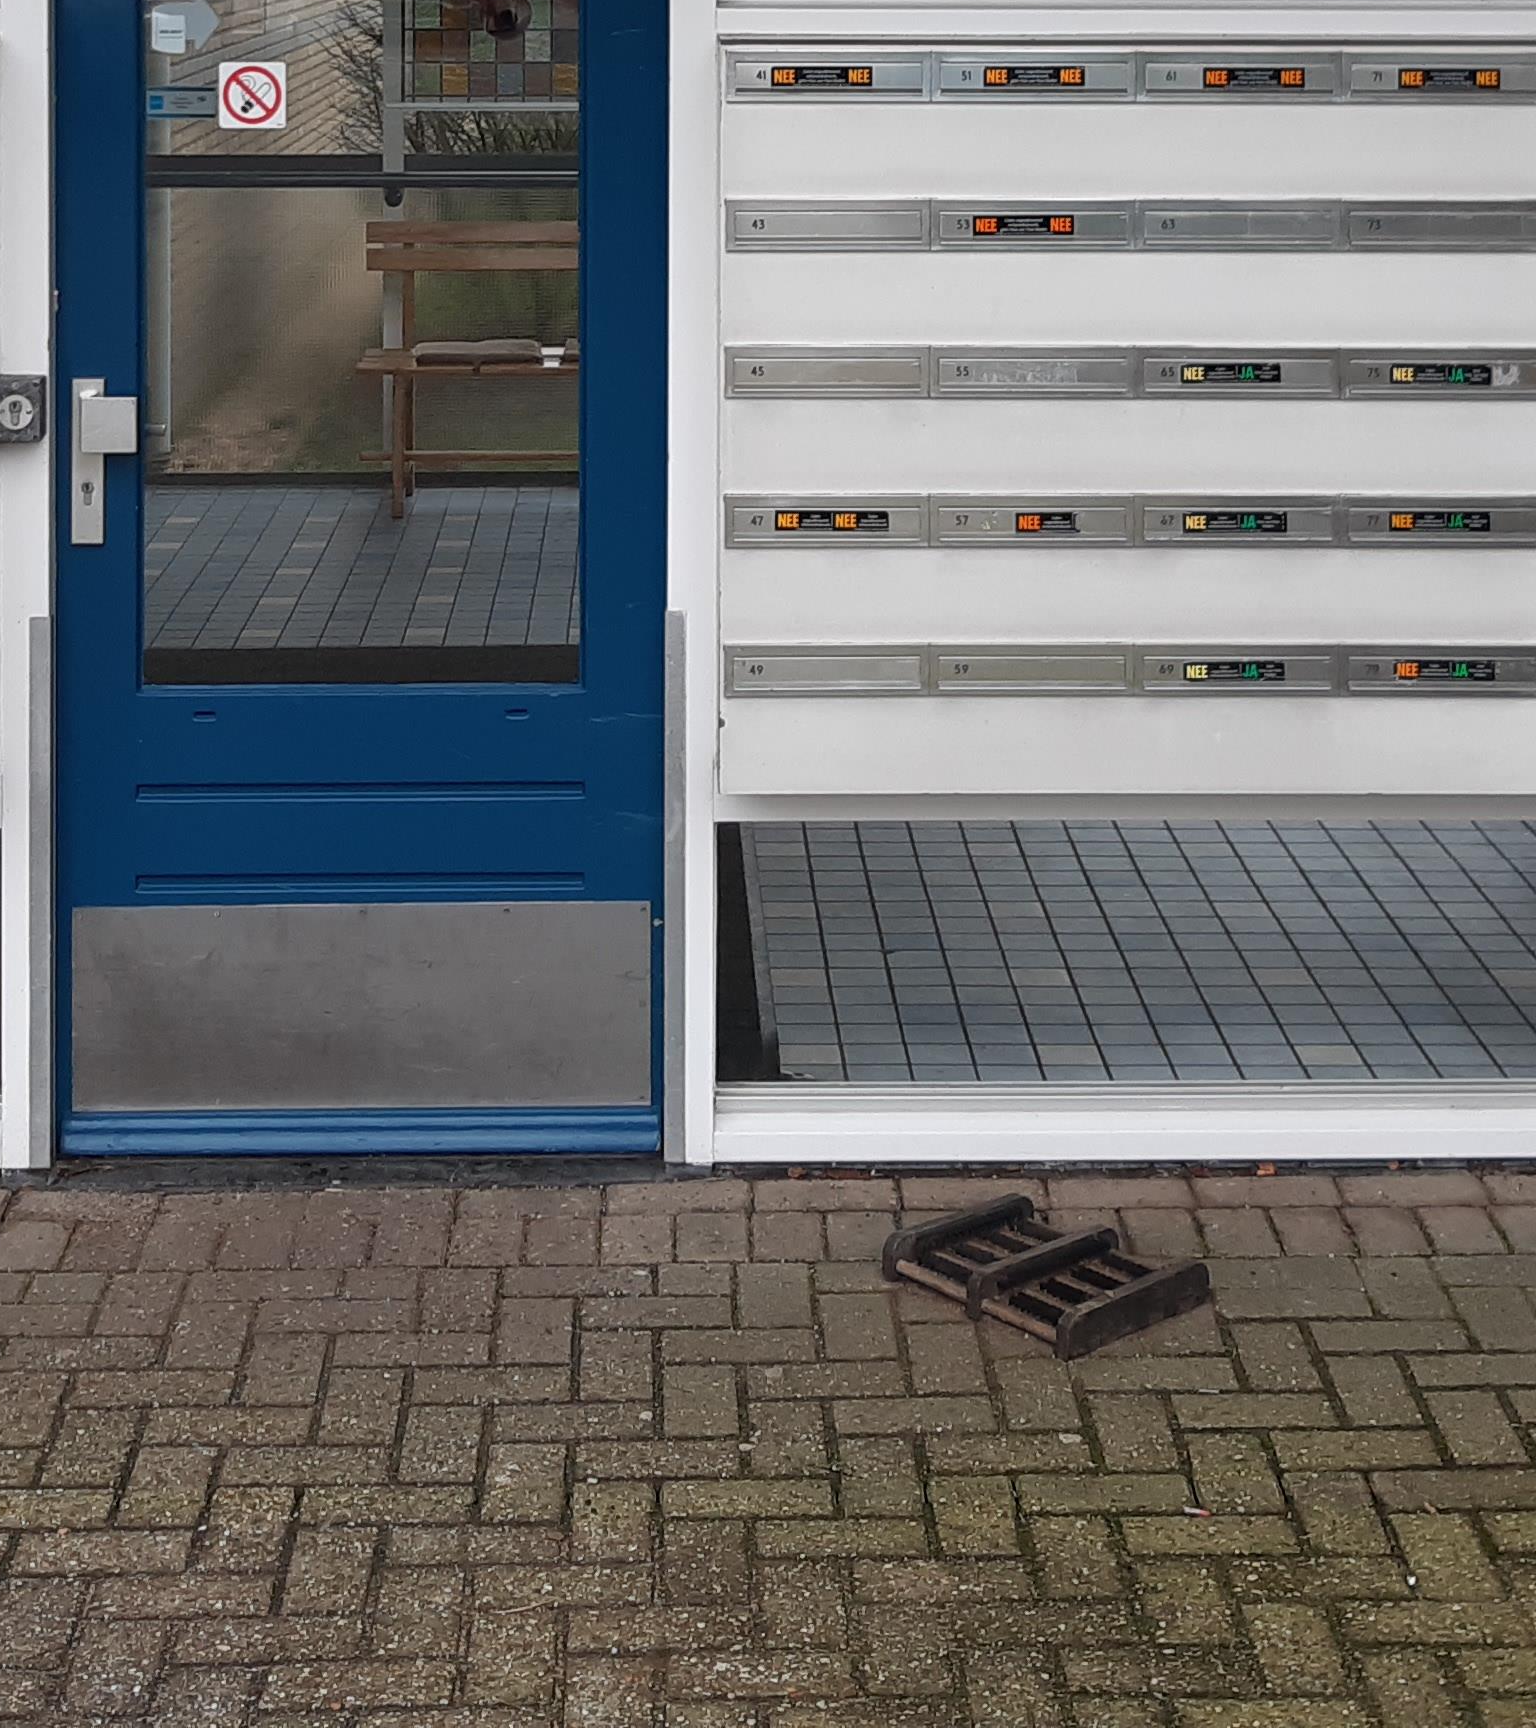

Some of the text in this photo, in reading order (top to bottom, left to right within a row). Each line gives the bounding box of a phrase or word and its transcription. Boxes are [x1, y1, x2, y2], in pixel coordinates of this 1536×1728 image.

[756, 69, 767, 81] 41
[774, 68, 795, 84] NEE
[849, 68, 870, 83] NEE
[961, 70, 972, 81] 51
[986, 68, 1008, 84] NEE
[1061, 68, 1082, 83] NEE
[1165, 70, 1177, 82] 61
[1206, 70, 1228, 85] NEE
[1281, 70, 1302, 85] NEE
[1373, 71, 1383, 82] 71
[1401, 71, 1423, 86] NEE
[1476, 71, 1498, 86] NEE
[751, 219, 765, 230] 43
[956, 218, 970, 230] 53
[976, 218, 997, 233] NEE
[1051, 217, 1072, 232] NEE
[1161, 218, 1175, 230] 63
[1367, 218, 1381, 230] 73
[751, 366, 765, 377] 45
[956, 366, 969, 377] 55
[1160, 367, 1175, 378] 65
[1183, 366, 1204, 381] NEE
[1239, 366, 1255, 381] JA
[1393, 367, 1414, 382] NEE
[1449, 367, 1464, 382] JA
[750, 515, 764, 526] 47
[777, 513, 799, 528] NEE
[835, 513, 857, 528] NEE
[956, 514, 969, 526] 57
[1018, 515, 1040, 531] NEE
[1185, 514, 1256, 530] NEE JA
[1391, 513, 1463, 529] NEE JA
[749, 665, 764, 676] 49
[954, 664, 969, 674] 59
[1159, 664, 1174, 675] 69
[1186, 663, 1258, 679] NEE JA
[1397, 662, 1468, 678] NEE JA
